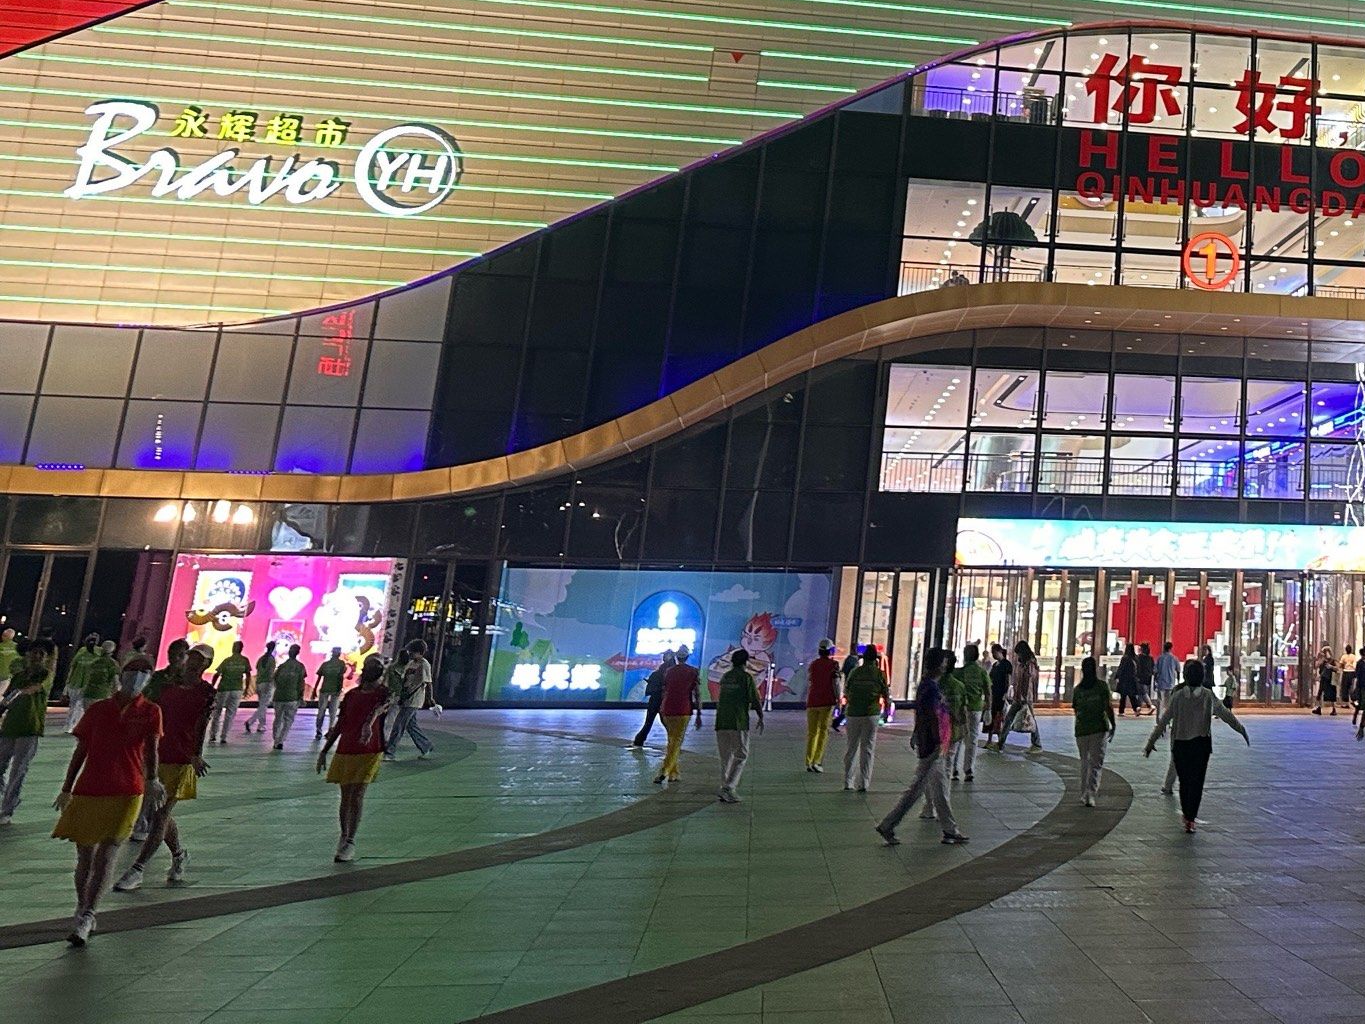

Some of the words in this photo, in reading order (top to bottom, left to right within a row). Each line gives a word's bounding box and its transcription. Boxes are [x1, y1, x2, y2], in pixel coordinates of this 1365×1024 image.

[63, 99, 342, 204] Bravo
[170, 108, 349, 147] 永辉超市
